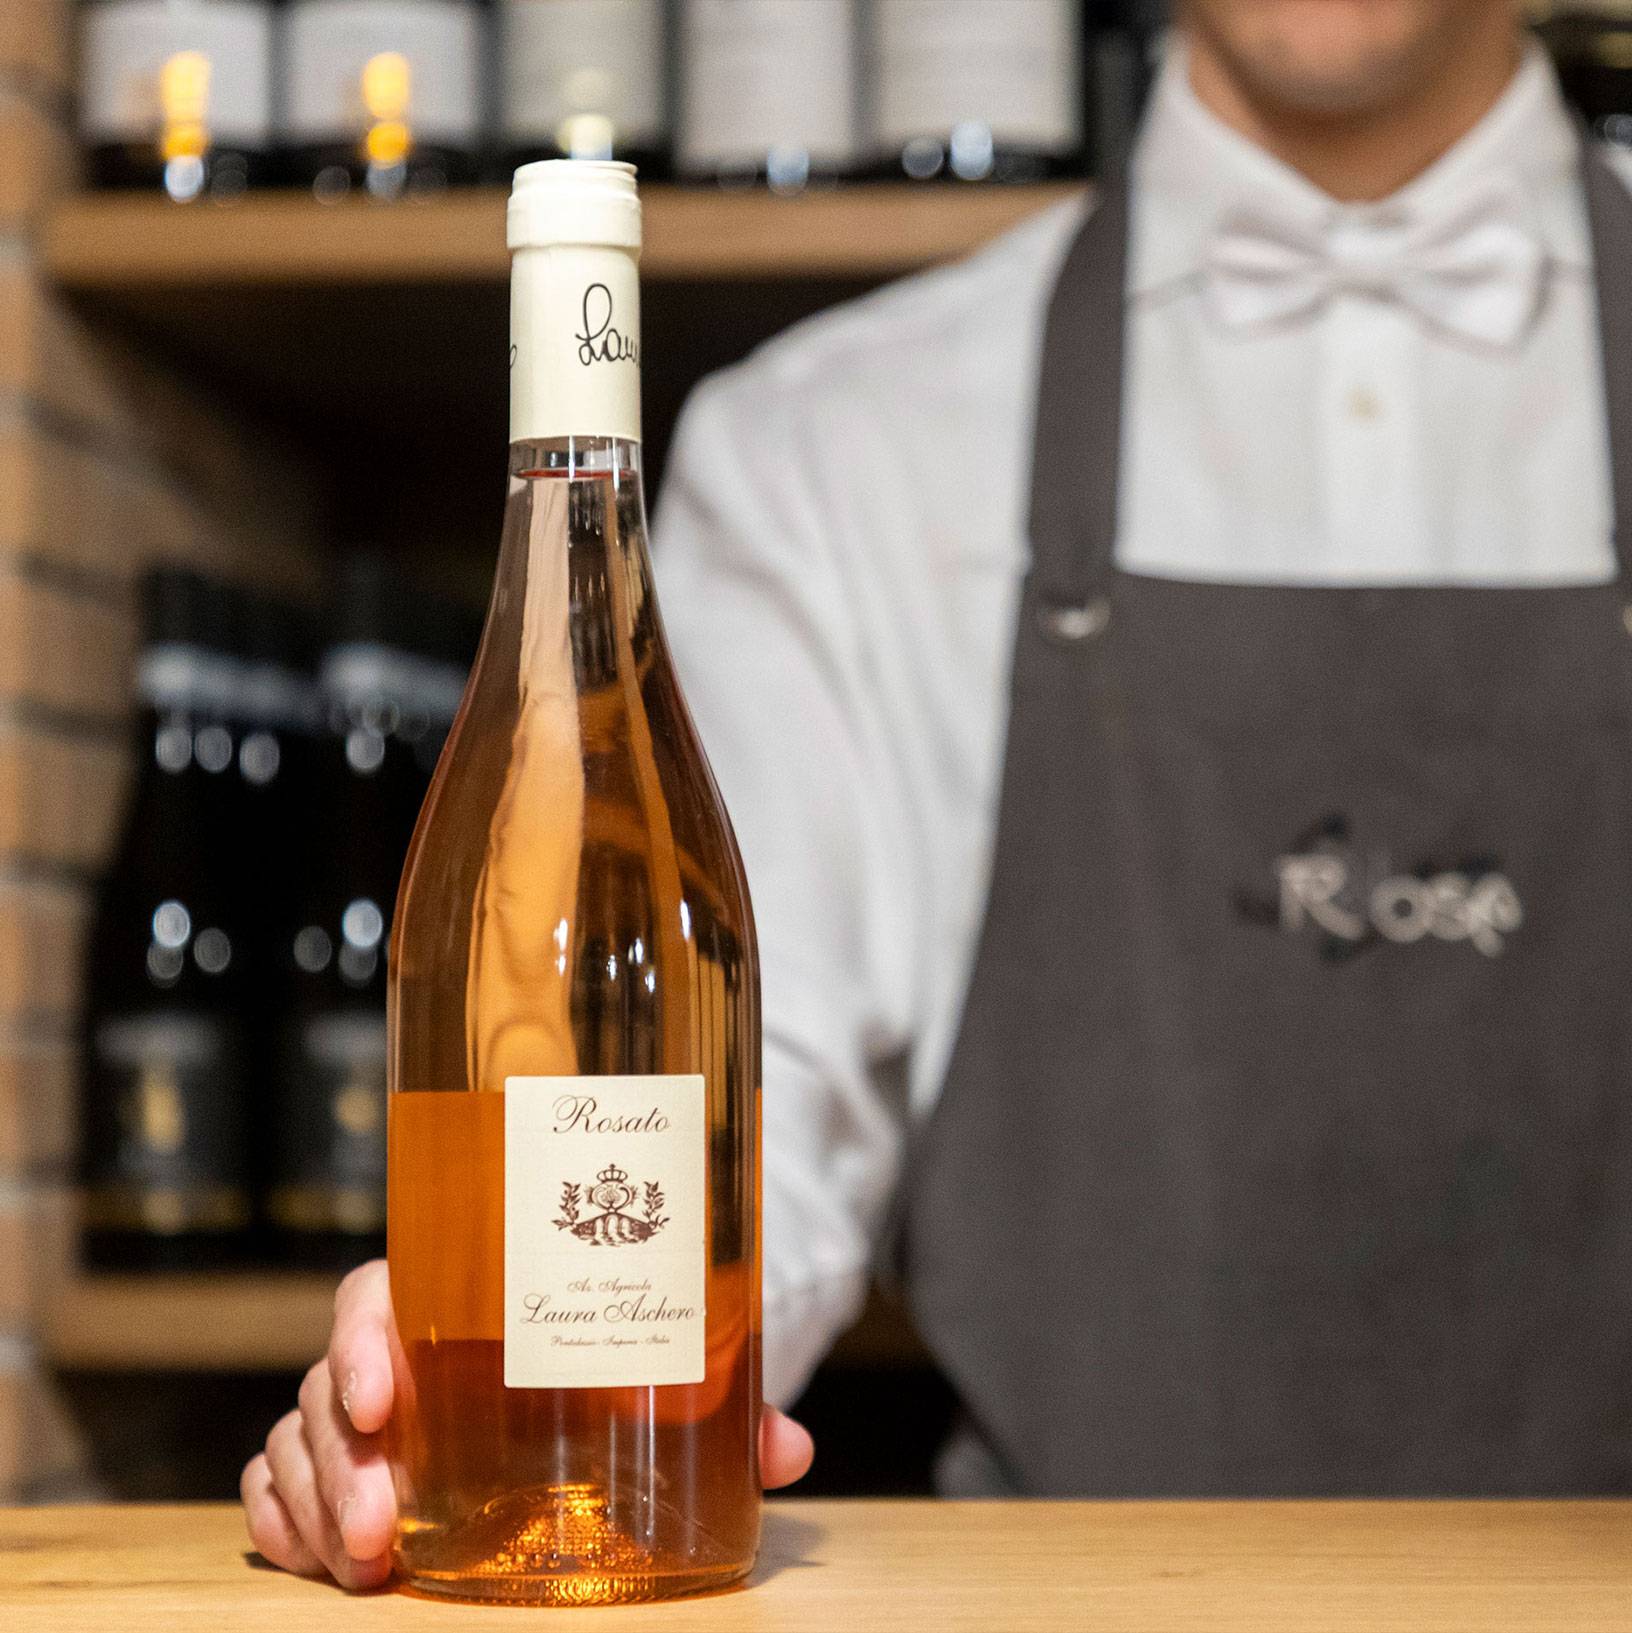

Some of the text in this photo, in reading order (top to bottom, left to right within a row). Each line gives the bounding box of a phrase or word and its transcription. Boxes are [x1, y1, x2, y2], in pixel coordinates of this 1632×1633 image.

[552, 1094, 671, 1134] Rosato
[598, 1277, 652, 1298] Agricola
[520, 1293, 695, 1324] Laura Aschero
